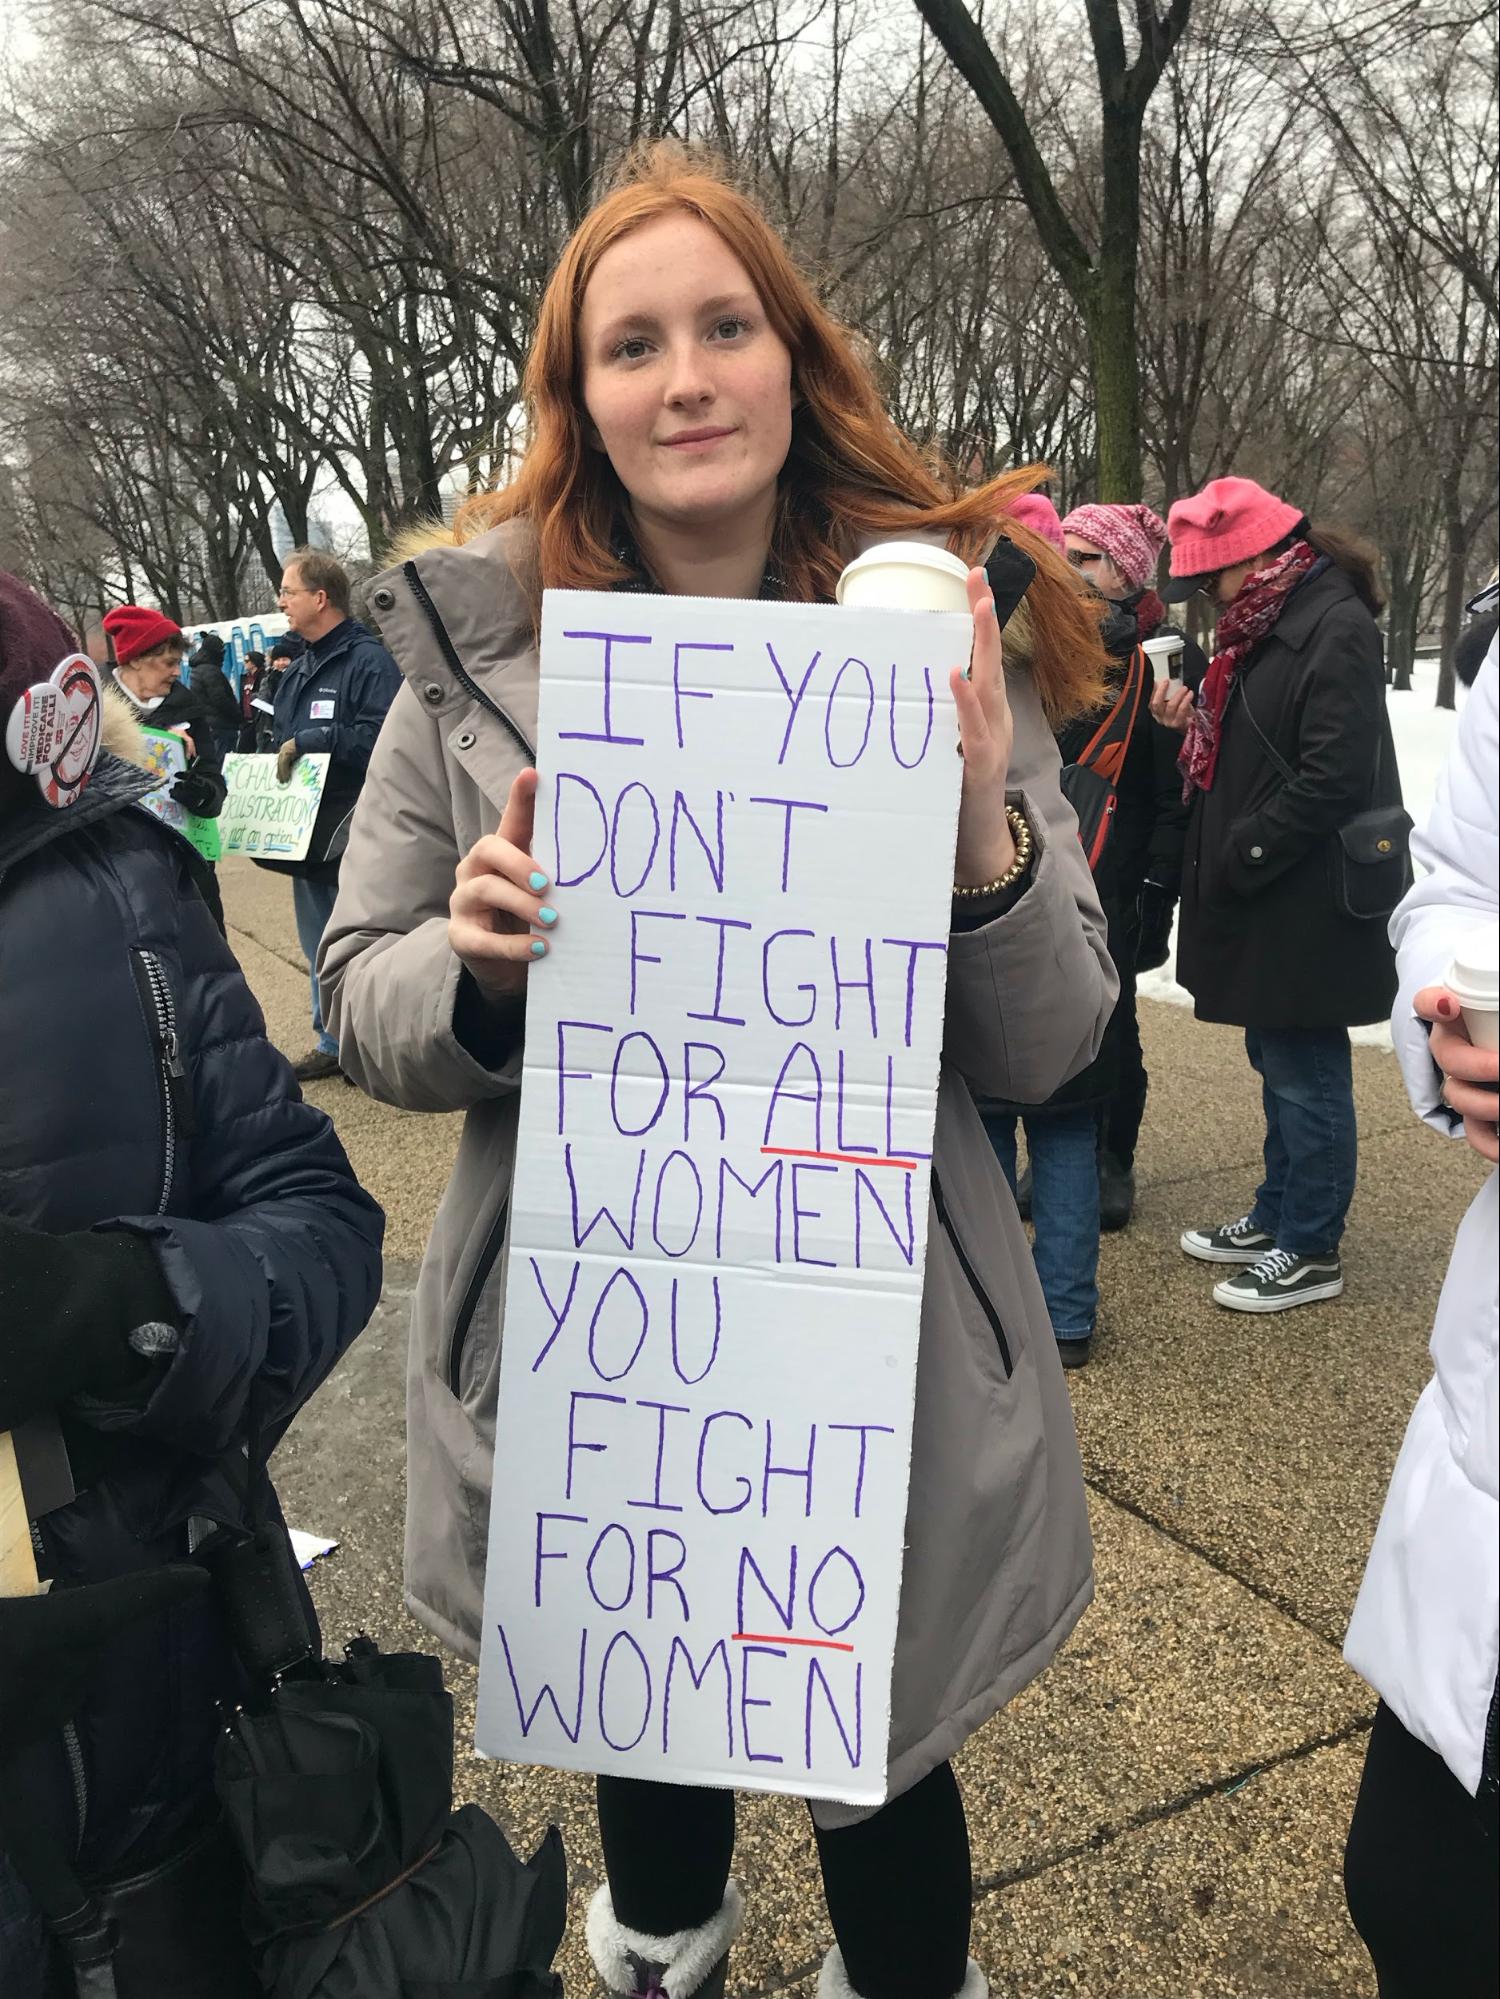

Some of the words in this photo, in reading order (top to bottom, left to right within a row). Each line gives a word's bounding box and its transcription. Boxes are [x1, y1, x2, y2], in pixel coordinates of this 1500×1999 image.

[20, 732, 29, 760] LOVE
[28, 712, 39, 759] IMPROVE
[35, 695, 48, 765] MEDICARE
[42, 732, 53, 763] FOR
[559, 630, 735, 748] IF
[766, 642, 934, 769] YOU
[228, 824, 246, 843] not
[247, 829, 261, 844] an
[555, 772, 829, 898] DON'T
[630, 909, 947, 1047] FIGHT
[556, 1020, 727, 1142] FOR
[763, 1041, 935, 1160] ALL
[564, 1143, 917, 1269] WOMEN
[529, 1256, 725, 1386] YOU
[566, 1390, 896, 1518] FIGHT
[534, 1512, 691, 1622] FOR
[737, 1544, 866, 1638] NO
[498, 1624, 863, 1769] WOMEN
